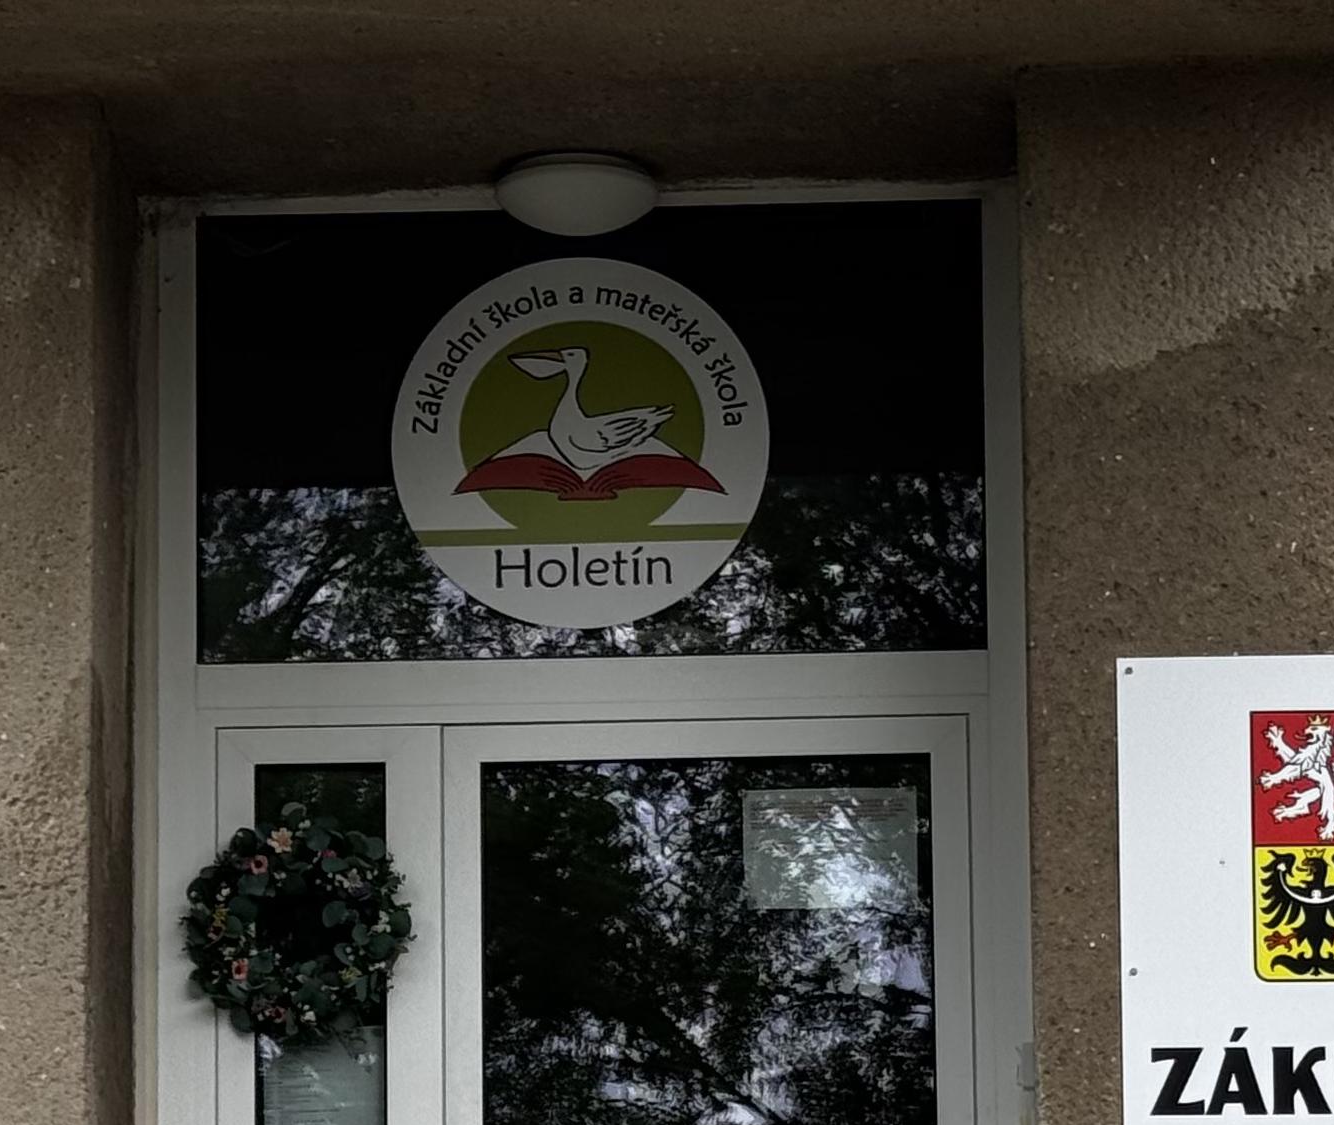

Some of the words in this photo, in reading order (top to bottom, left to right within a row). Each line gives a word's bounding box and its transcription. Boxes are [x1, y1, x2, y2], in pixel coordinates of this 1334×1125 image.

[413, 317, 487, 434] Základní
[482, 286, 559, 329] škola
[568, 286, 584, 305] a
[595, 286, 717, 357] mateřská
[703, 353, 748, 427] škola
[494, 546, 673, 589] Holetín
